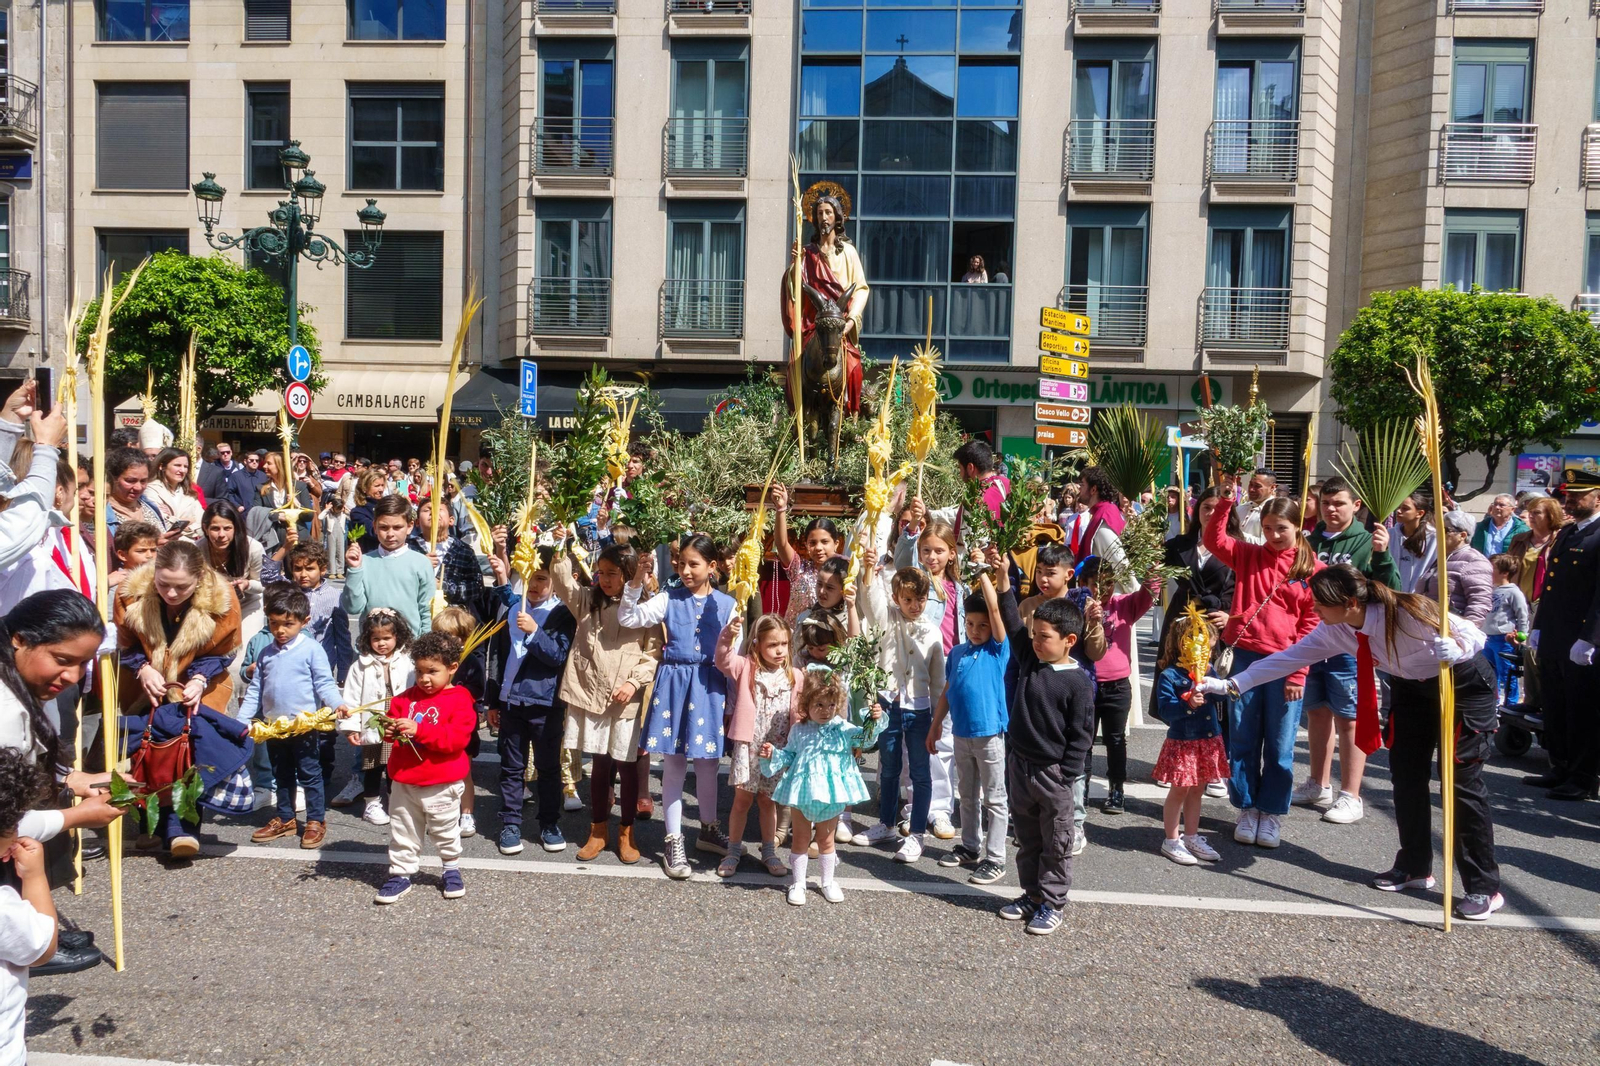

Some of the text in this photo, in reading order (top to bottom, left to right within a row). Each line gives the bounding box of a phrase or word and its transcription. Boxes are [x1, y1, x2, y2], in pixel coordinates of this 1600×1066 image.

[1044, 309, 1067, 320] Estación
[1043, 333, 1058, 341] porto
[1043, 341, 1068, 351] deportivo
[1042, 358, 1060, 366] oficina
[1042, 365, 1062, 373] turismo
[525, 369, 533, 389] P
[973, 377, 1041, 403] Ortoped
[292, 393, 307, 407] 30
[337, 393, 426, 409] CAMBALACHE
[1038, 407, 1071, 417] Casco Vello
[121, 417, 140, 425] 1906
[203, 417, 269, 430] CAMBALACHE
[548, 416, 562, 429] LA
[1037, 430, 1055, 439] praias
